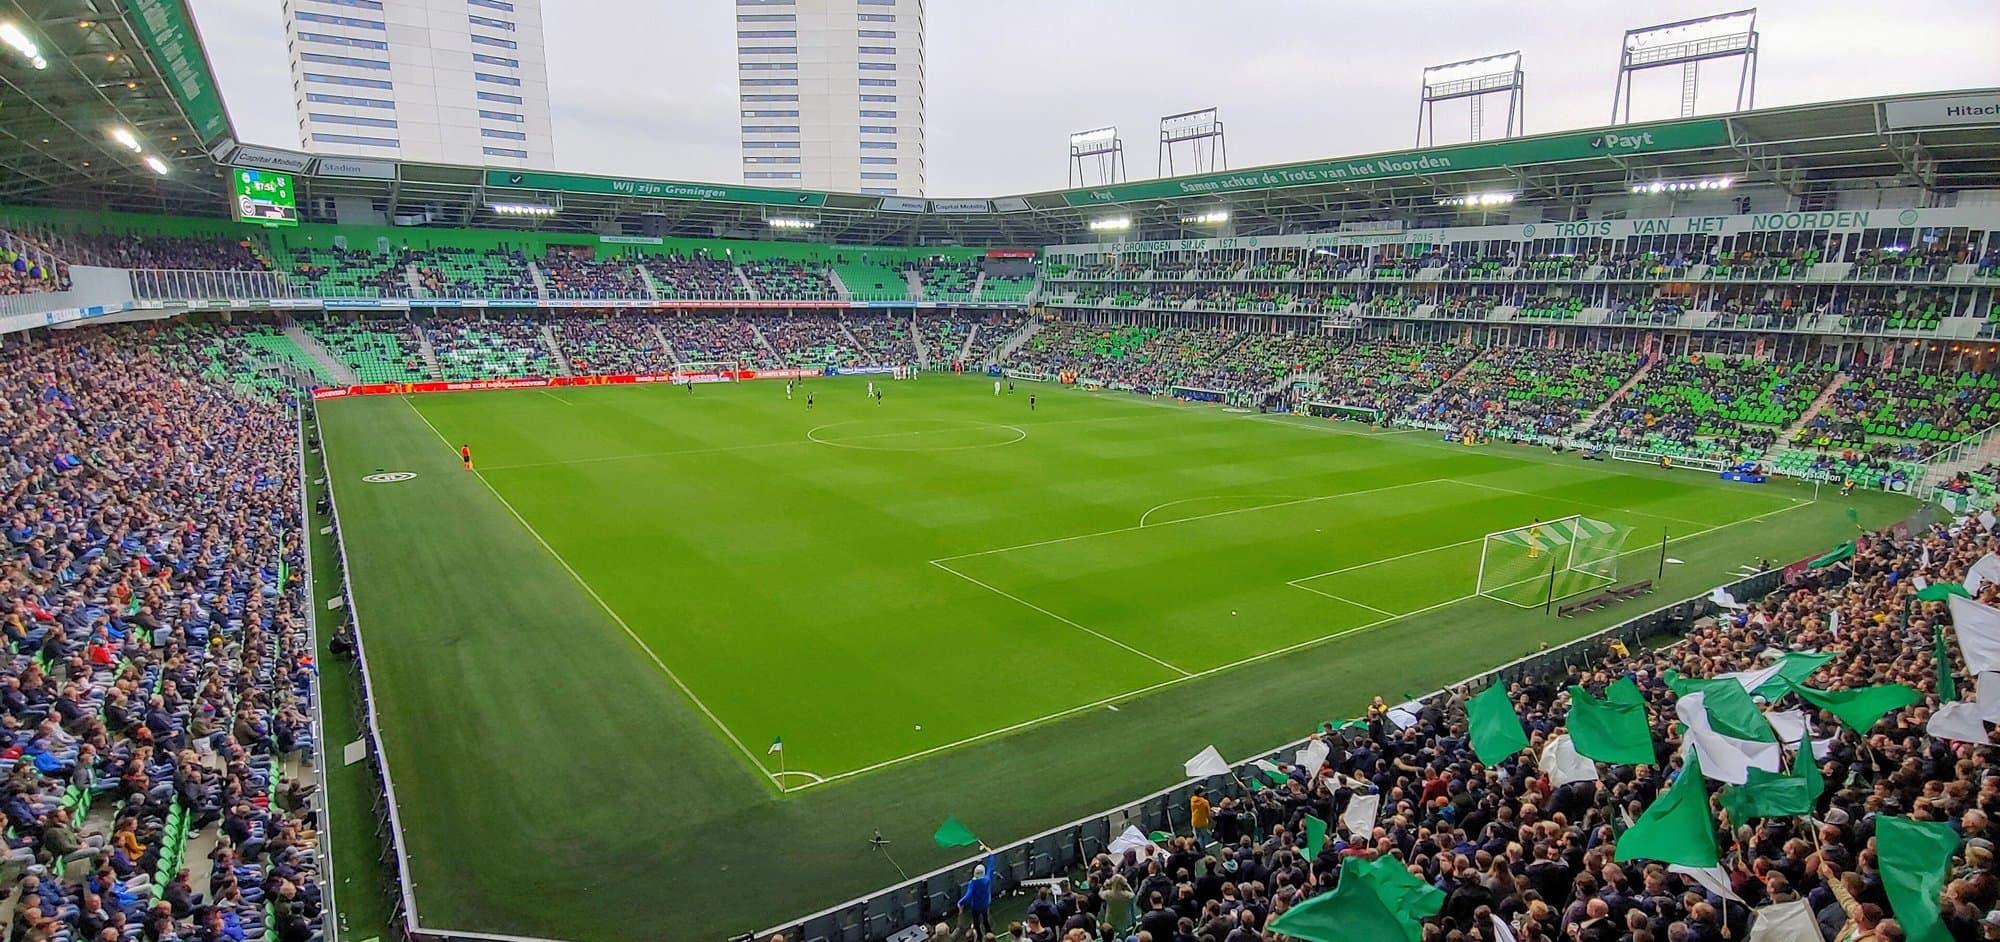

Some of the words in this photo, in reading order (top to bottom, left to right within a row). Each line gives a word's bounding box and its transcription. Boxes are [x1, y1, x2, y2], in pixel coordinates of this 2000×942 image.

[1605, 132, 1654, 150] Payt
[239, 153, 271, 164] Capital
[272, 157, 303, 169] Mobility
[324, 164, 361, 173] Stadion
[1180, 181, 1218, 193] Samen
[1221, 176, 1258, 188] achter
[1262, 172, 1279, 184] de
[1280, 170, 1317, 182] Trots
[1320, 168, 1346, 179] van
[1349, 163, 1376, 176] het
[1377, 156, 1451, 172] Noorden
[245, 187, 252, 195] 2
[280, 190, 286, 198] 0
[612, 181, 634, 194] Wij
[638, 183, 660, 196] zijn
[665, 184, 726, 198] Groningen
[1094, 190, 1115, 200] Payt
[1555, 222, 1612, 237] TROTS
[1633, 220, 1670, 234] VAN
[1688, 217, 1728, 232] HET
[1752, 212, 1870, 230] NOORDEN
[1112, 243, 1120, 252] FC
[1124, 241, 1171, 252] GRONINGEN
[1808, 468, 1841, 482] Stadon
